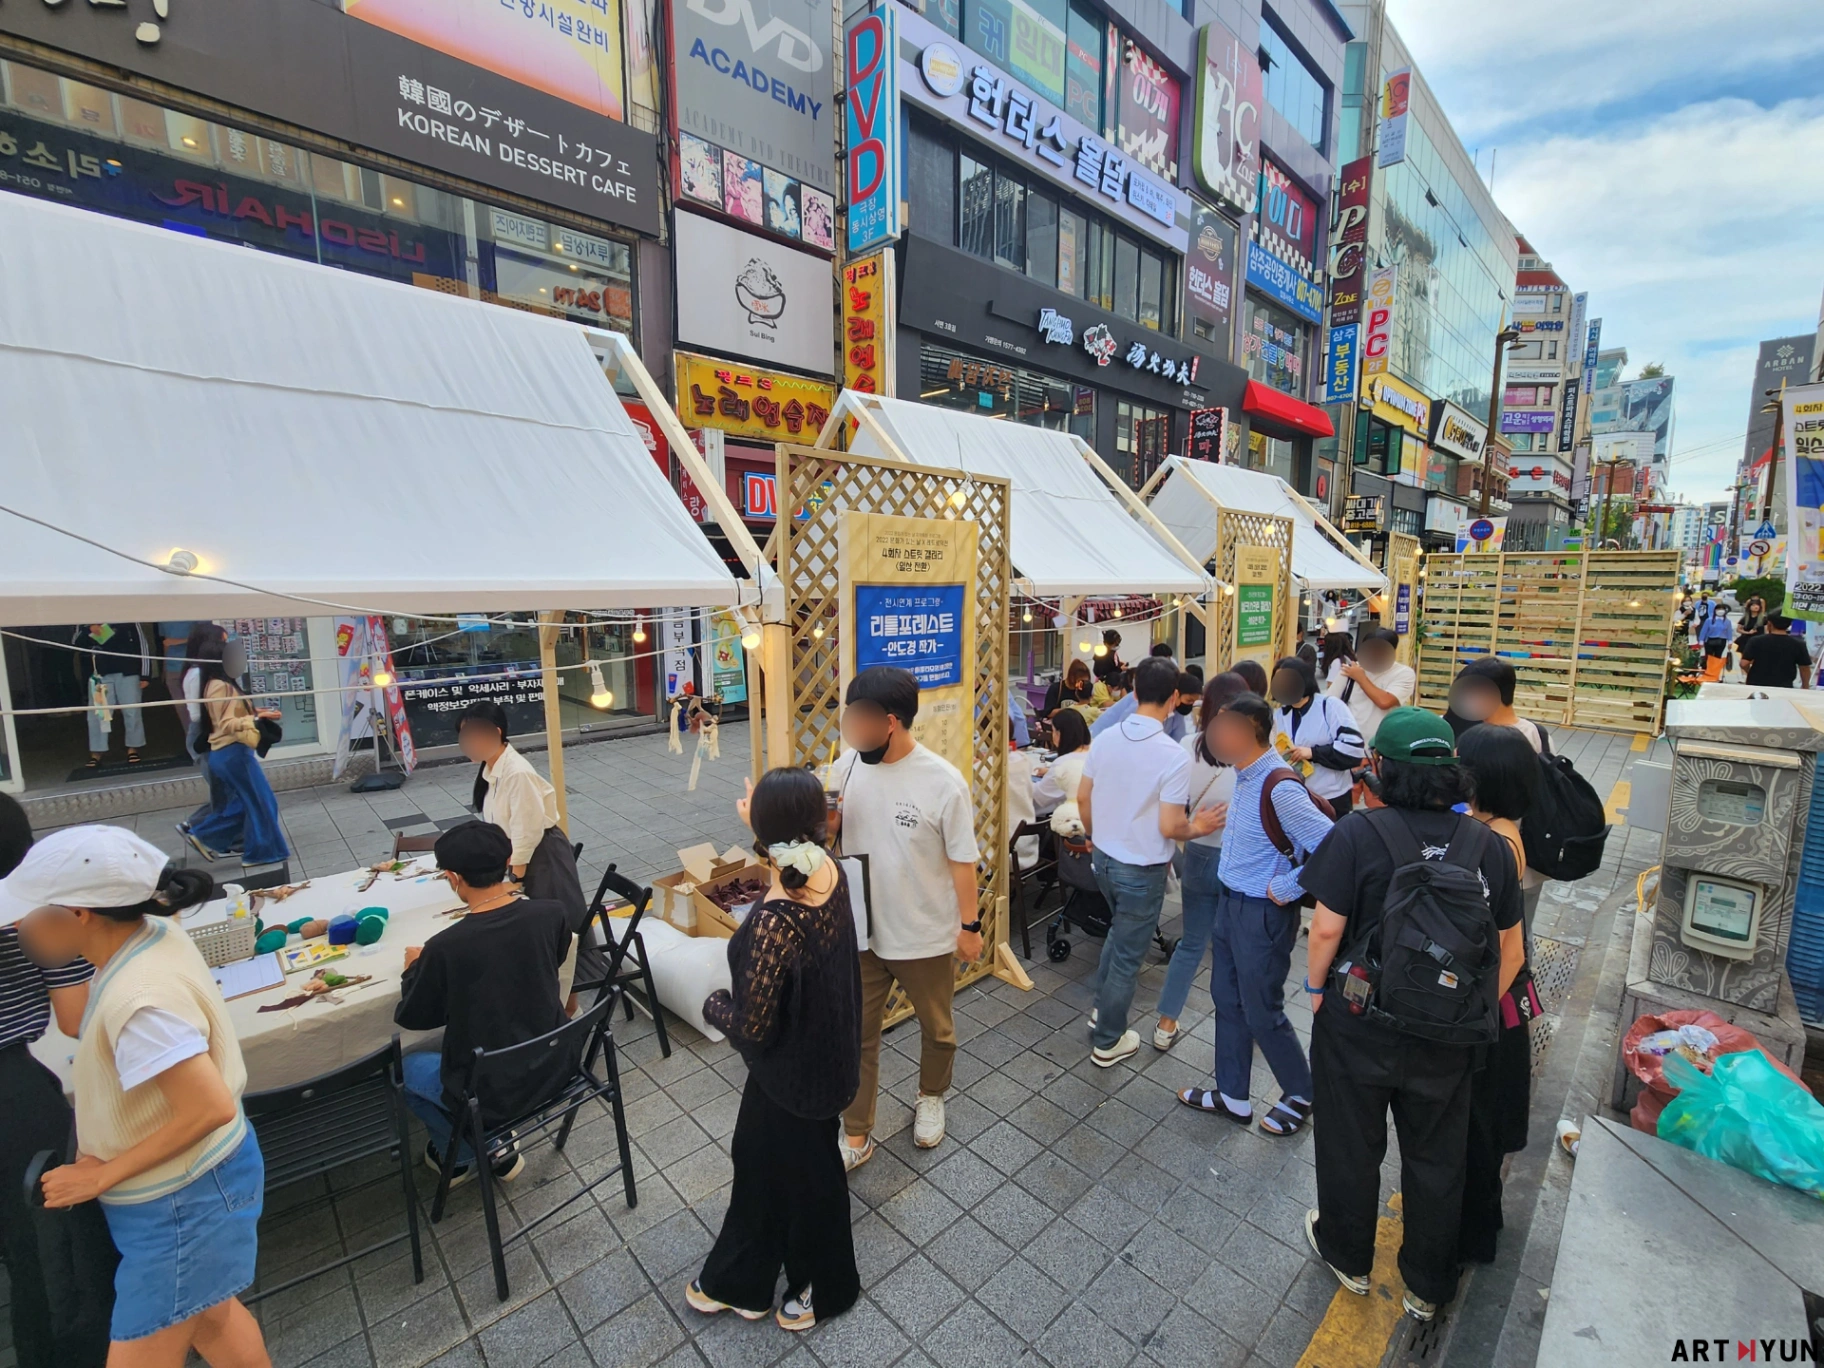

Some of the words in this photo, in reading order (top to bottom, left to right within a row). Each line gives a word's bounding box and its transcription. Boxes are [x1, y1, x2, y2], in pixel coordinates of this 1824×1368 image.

[689, 37, 822, 121] ACADEMY
[848, 15, 886, 206] DVD
[399, 75, 631, 176] 韓國のデザートカフェ
[968, 65, 1067, 168] 헌터스
[1073, 136, 1128, 201] 홀덤
[398, 108, 491, 156] KOREAN
[499, 143, 587, 187] DESSERT
[592, 175, 636, 203] CAFE
[684, 106, 744, 148] ACADEMY
[751, 135, 774, 161] DVD
[780, 148, 830, 187] THEATRE
[1341, 176, 1367, 197] [수]
[851, 207, 886, 234] 동시상영
[862, 228, 875, 243] 3F
[1250, 246, 1297, 297] 삼주공인중개사
[1188, 265, 1213, 300] 헌터스
[1213, 280, 1230, 310] 홀덤
[1334, 292, 1358, 306] ZONE
[750, 329, 760, 340] Sul
[761, 331, 775, 343] Bing
[1333, 328, 1356, 342] 삼주
[1365, 309, 1389, 358] PC
[1333, 344, 1350, 392] 부동산
[1368, 360, 1383, 372] 2F
[1764, 356, 1805, 368] ARBAN
[904, 549, 923, 560] 스트릿
[924, 549, 943, 560] 갤러리
[870, 613, 953, 637] 리틀포레스트
[404, 686, 448, 701] 폰케이스
[452, 685, 463, 696] 및
[468, 681, 509, 694] 악세사리
[493, 694, 514, 706] 부착
[515, 693, 527, 704] 및
